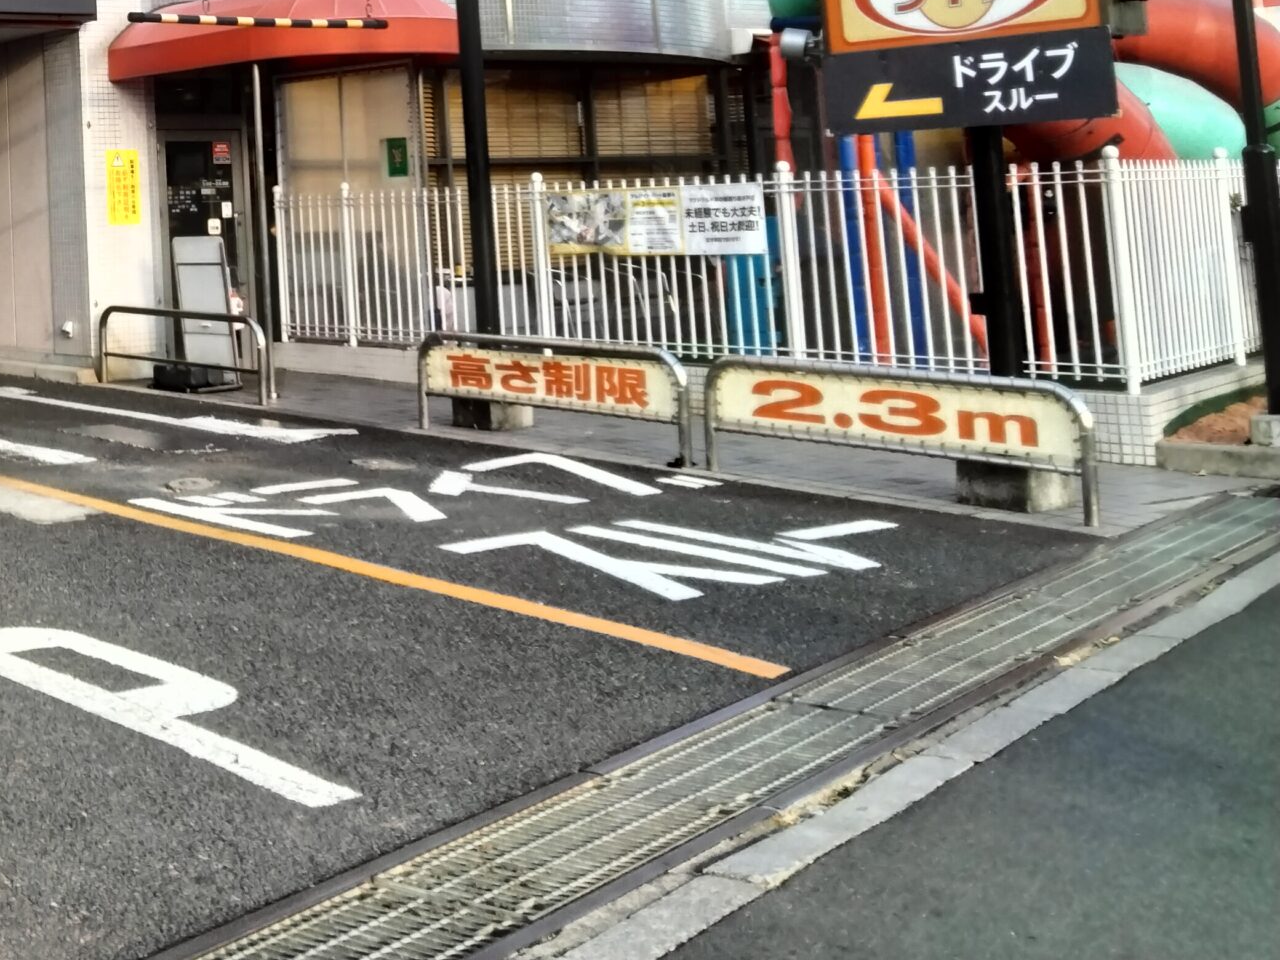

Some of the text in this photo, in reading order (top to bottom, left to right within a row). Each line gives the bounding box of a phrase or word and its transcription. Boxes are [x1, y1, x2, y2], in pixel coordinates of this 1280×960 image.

[952, 41, 1079, 88] ドライブ
[983, 87, 1059, 113] スルー
[447, 354, 649, 409] 高さ制限
[751, 379, 1040, 448] 2.3m
